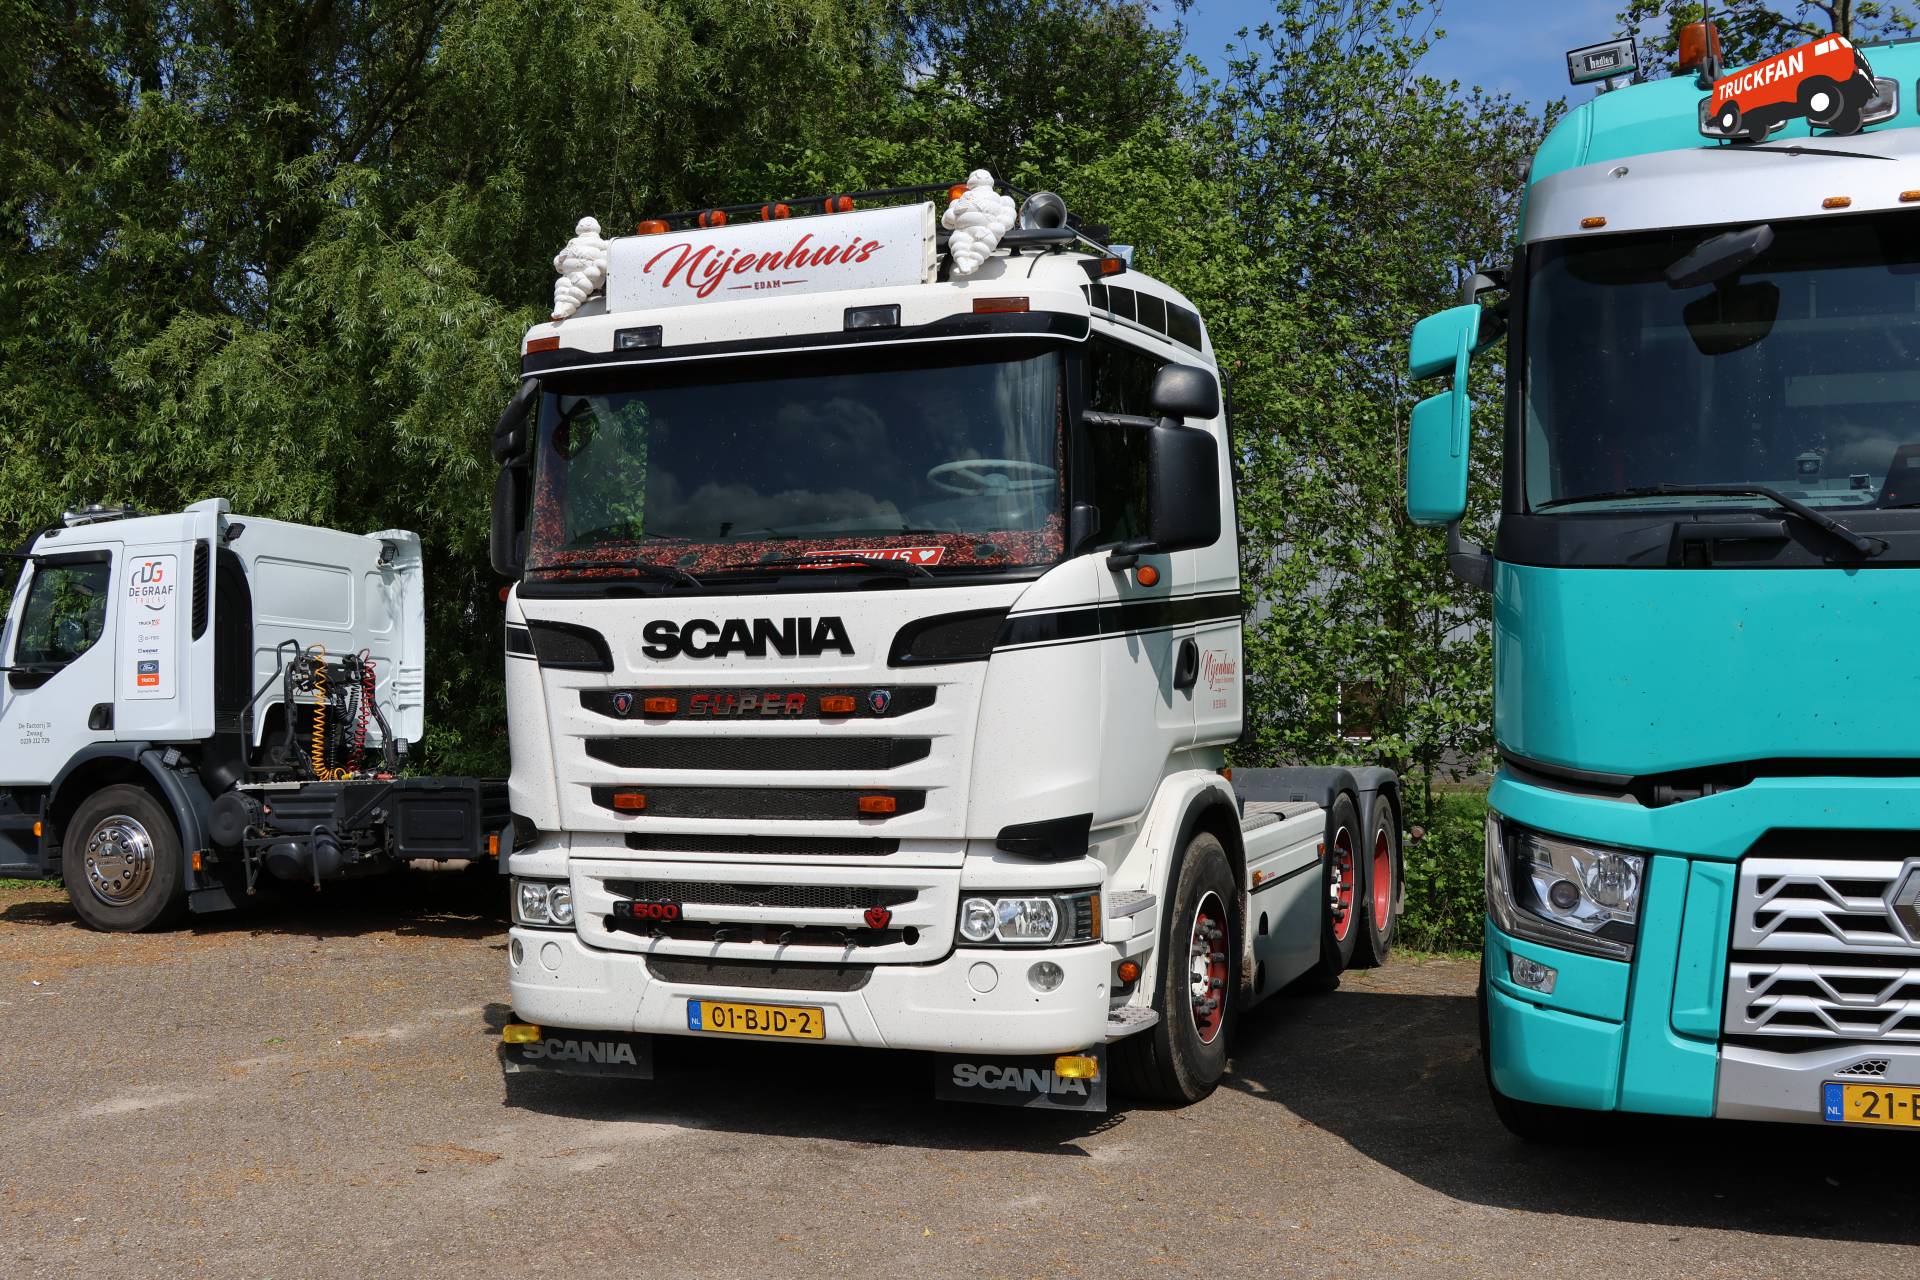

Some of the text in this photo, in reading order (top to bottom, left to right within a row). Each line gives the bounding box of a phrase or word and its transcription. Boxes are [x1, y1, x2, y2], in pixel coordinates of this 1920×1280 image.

[1589, 55, 1614, 69] hadley
[643, 233, 885, 299] Nijenhuis
[754, 280, 781, 290] EDAM
[129, 585, 174, 597] DE GRAAF
[642, 617, 855, 659] SCANIA
[689, 693, 807, 715] SUPER
[633, 903, 680, 919] 500
[712, 1006, 812, 1034] 01-BJD-2
[523, 1038, 637, 1065] SCANIA
[953, 1063, 1088, 1095] SCANIA
[1827, 1106, 1841, 1115] NL
